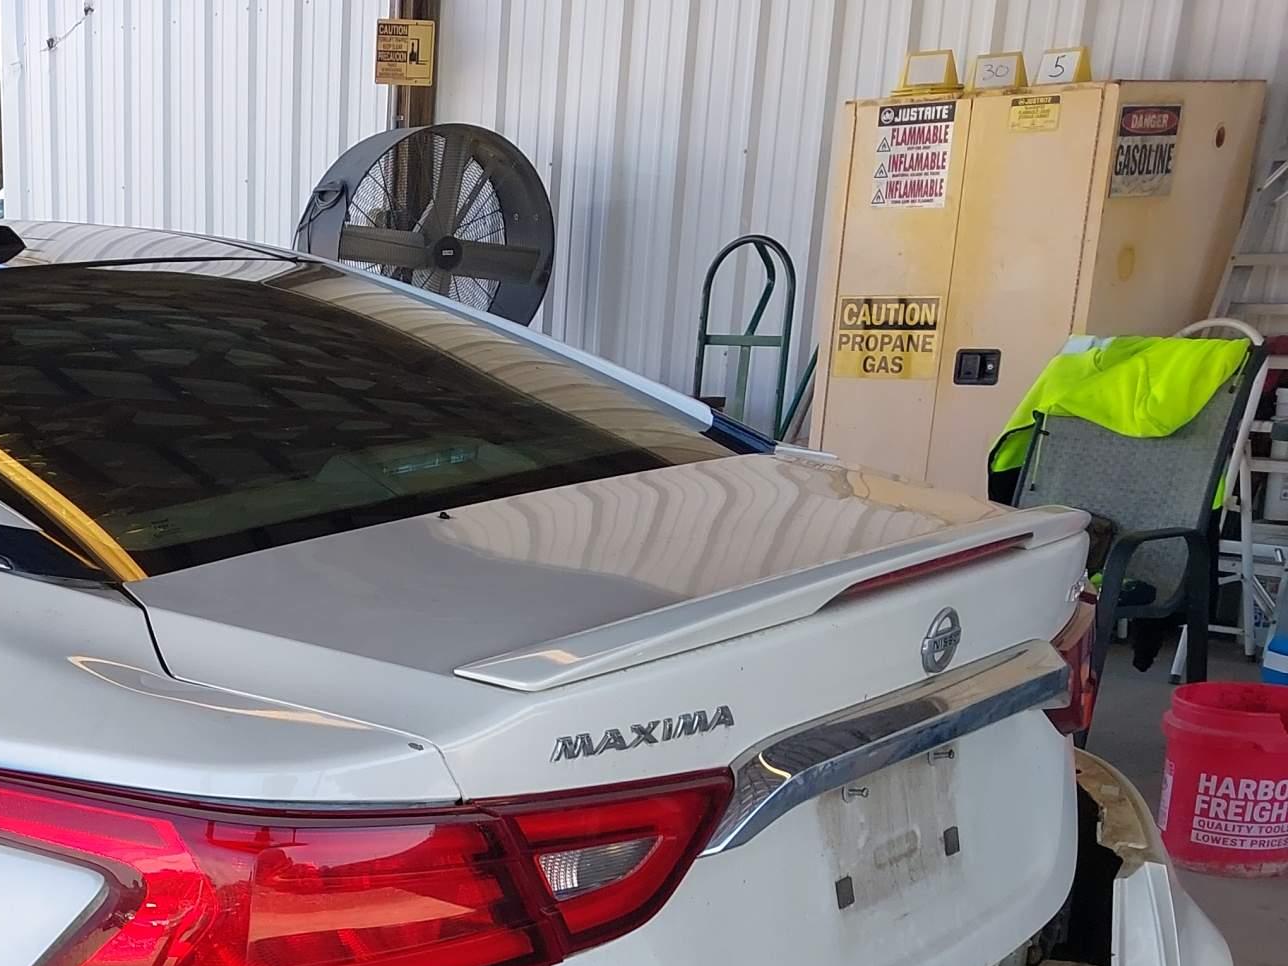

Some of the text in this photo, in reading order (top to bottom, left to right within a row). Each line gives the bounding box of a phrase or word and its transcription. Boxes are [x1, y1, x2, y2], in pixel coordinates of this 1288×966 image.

[379, 25, 408, 35] CAUTION
[982, 64, 1009, 81] 30
[1048, 55, 1066, 78] 5
[894, 106, 949, 122] JUSTRITE
[1131, 114, 1168, 129] DANGER
[890, 125, 950, 146] FLAMMABLE
[888, 151, 947, 172] INFLAMABLE
[1114, 144, 1175, 176] GASOLINE
[843, 303, 935, 326] CAUTION
[838, 334, 935, 352] PROPANE
[862, 355, 903, 374] GAS
[550, 705, 734, 763] MAXIMA
[1197, 820, 1288, 834] QUALITY TOOL
[1195, 833, 1248, 847] LOWEST
